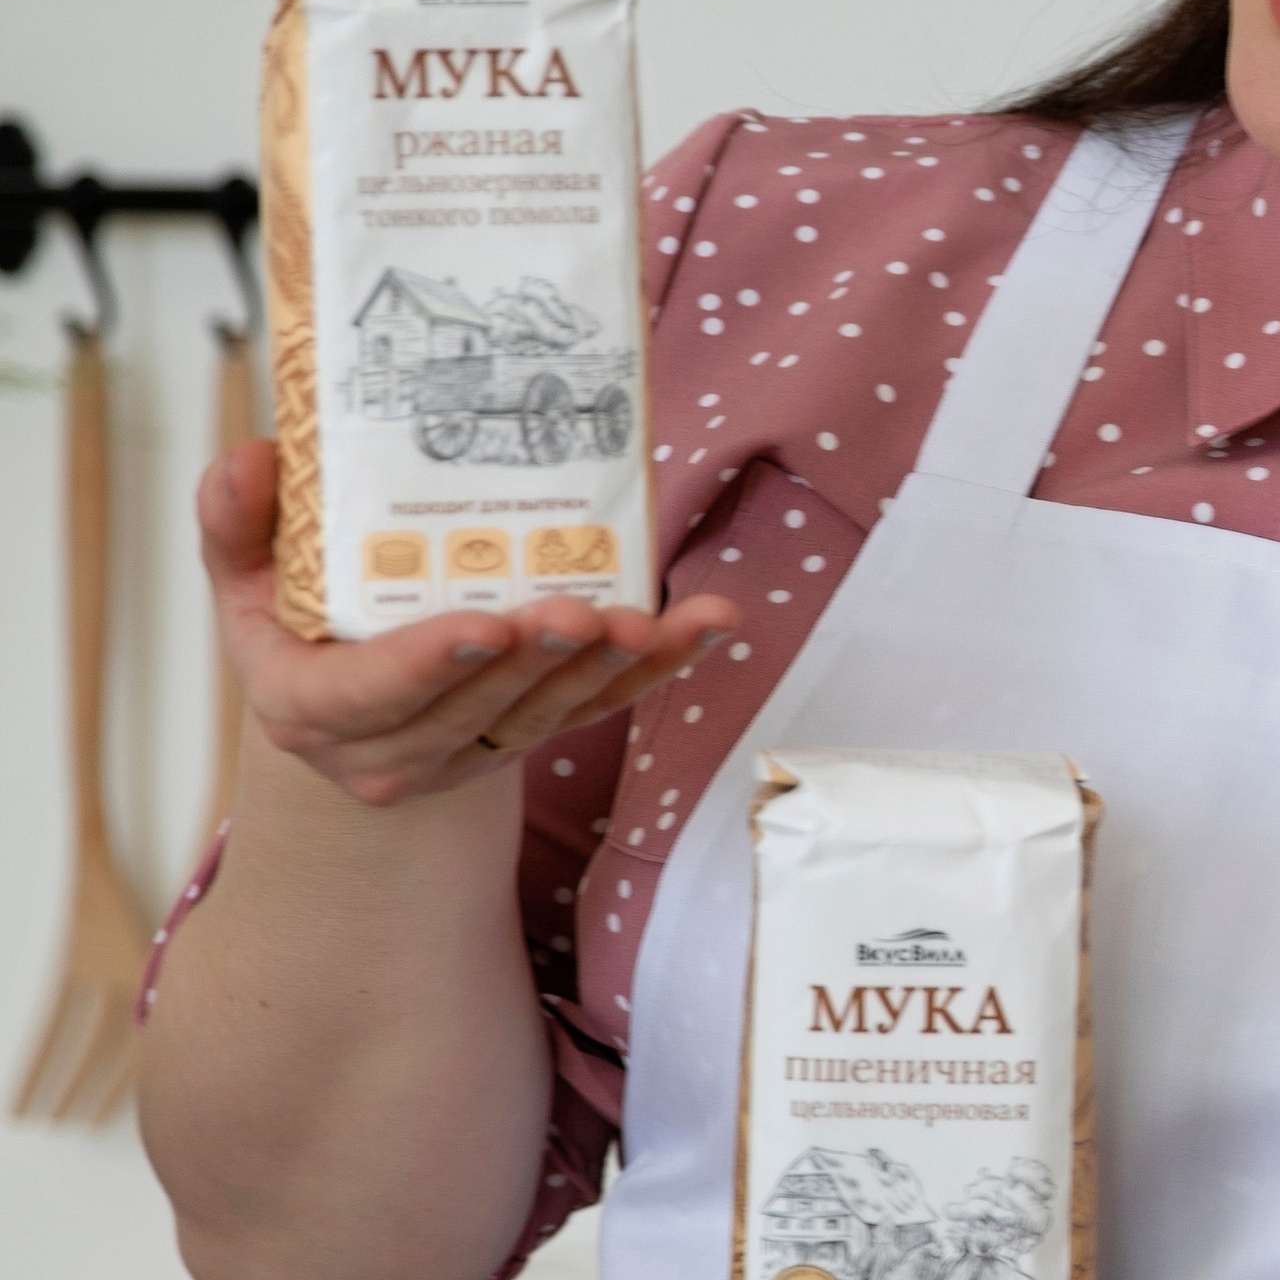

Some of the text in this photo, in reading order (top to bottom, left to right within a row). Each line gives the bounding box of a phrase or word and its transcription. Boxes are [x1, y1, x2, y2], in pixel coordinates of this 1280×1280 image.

[372, 48, 582, 99] МУКА
[393, 129, 564, 169] ржаная
[808, 984, 1014, 1035] МУКА
[784, 1056, 1037, 1085] пшеничная
[790, 1099, 1029, 1127] цельнозерновая
